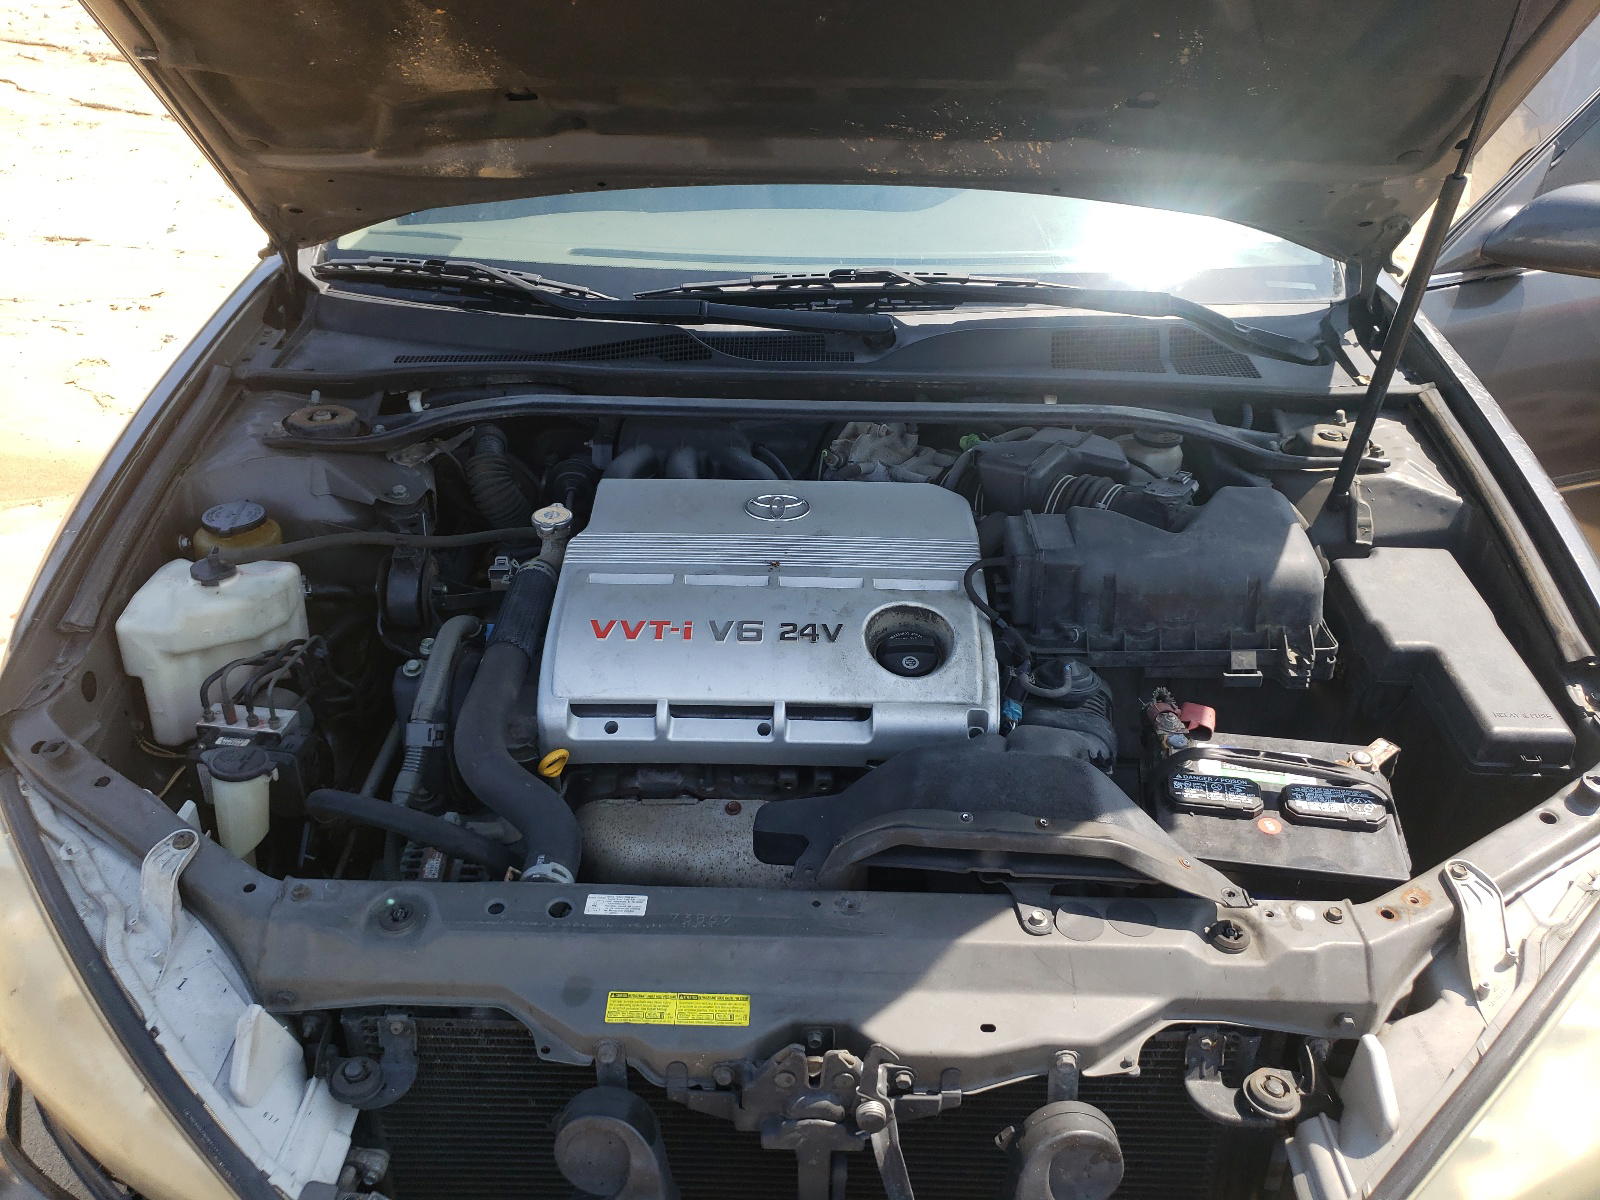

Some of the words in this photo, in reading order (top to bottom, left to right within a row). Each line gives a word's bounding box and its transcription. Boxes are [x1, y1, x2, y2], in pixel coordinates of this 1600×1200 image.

[589, 619, 694, 642] VVT-i
[708, 619, 765, 643] V6
[778, 622, 844, 644] 24V
[1182, 774, 1213, 782] DANGER
[1220, 777, 1248, 785] POISON
